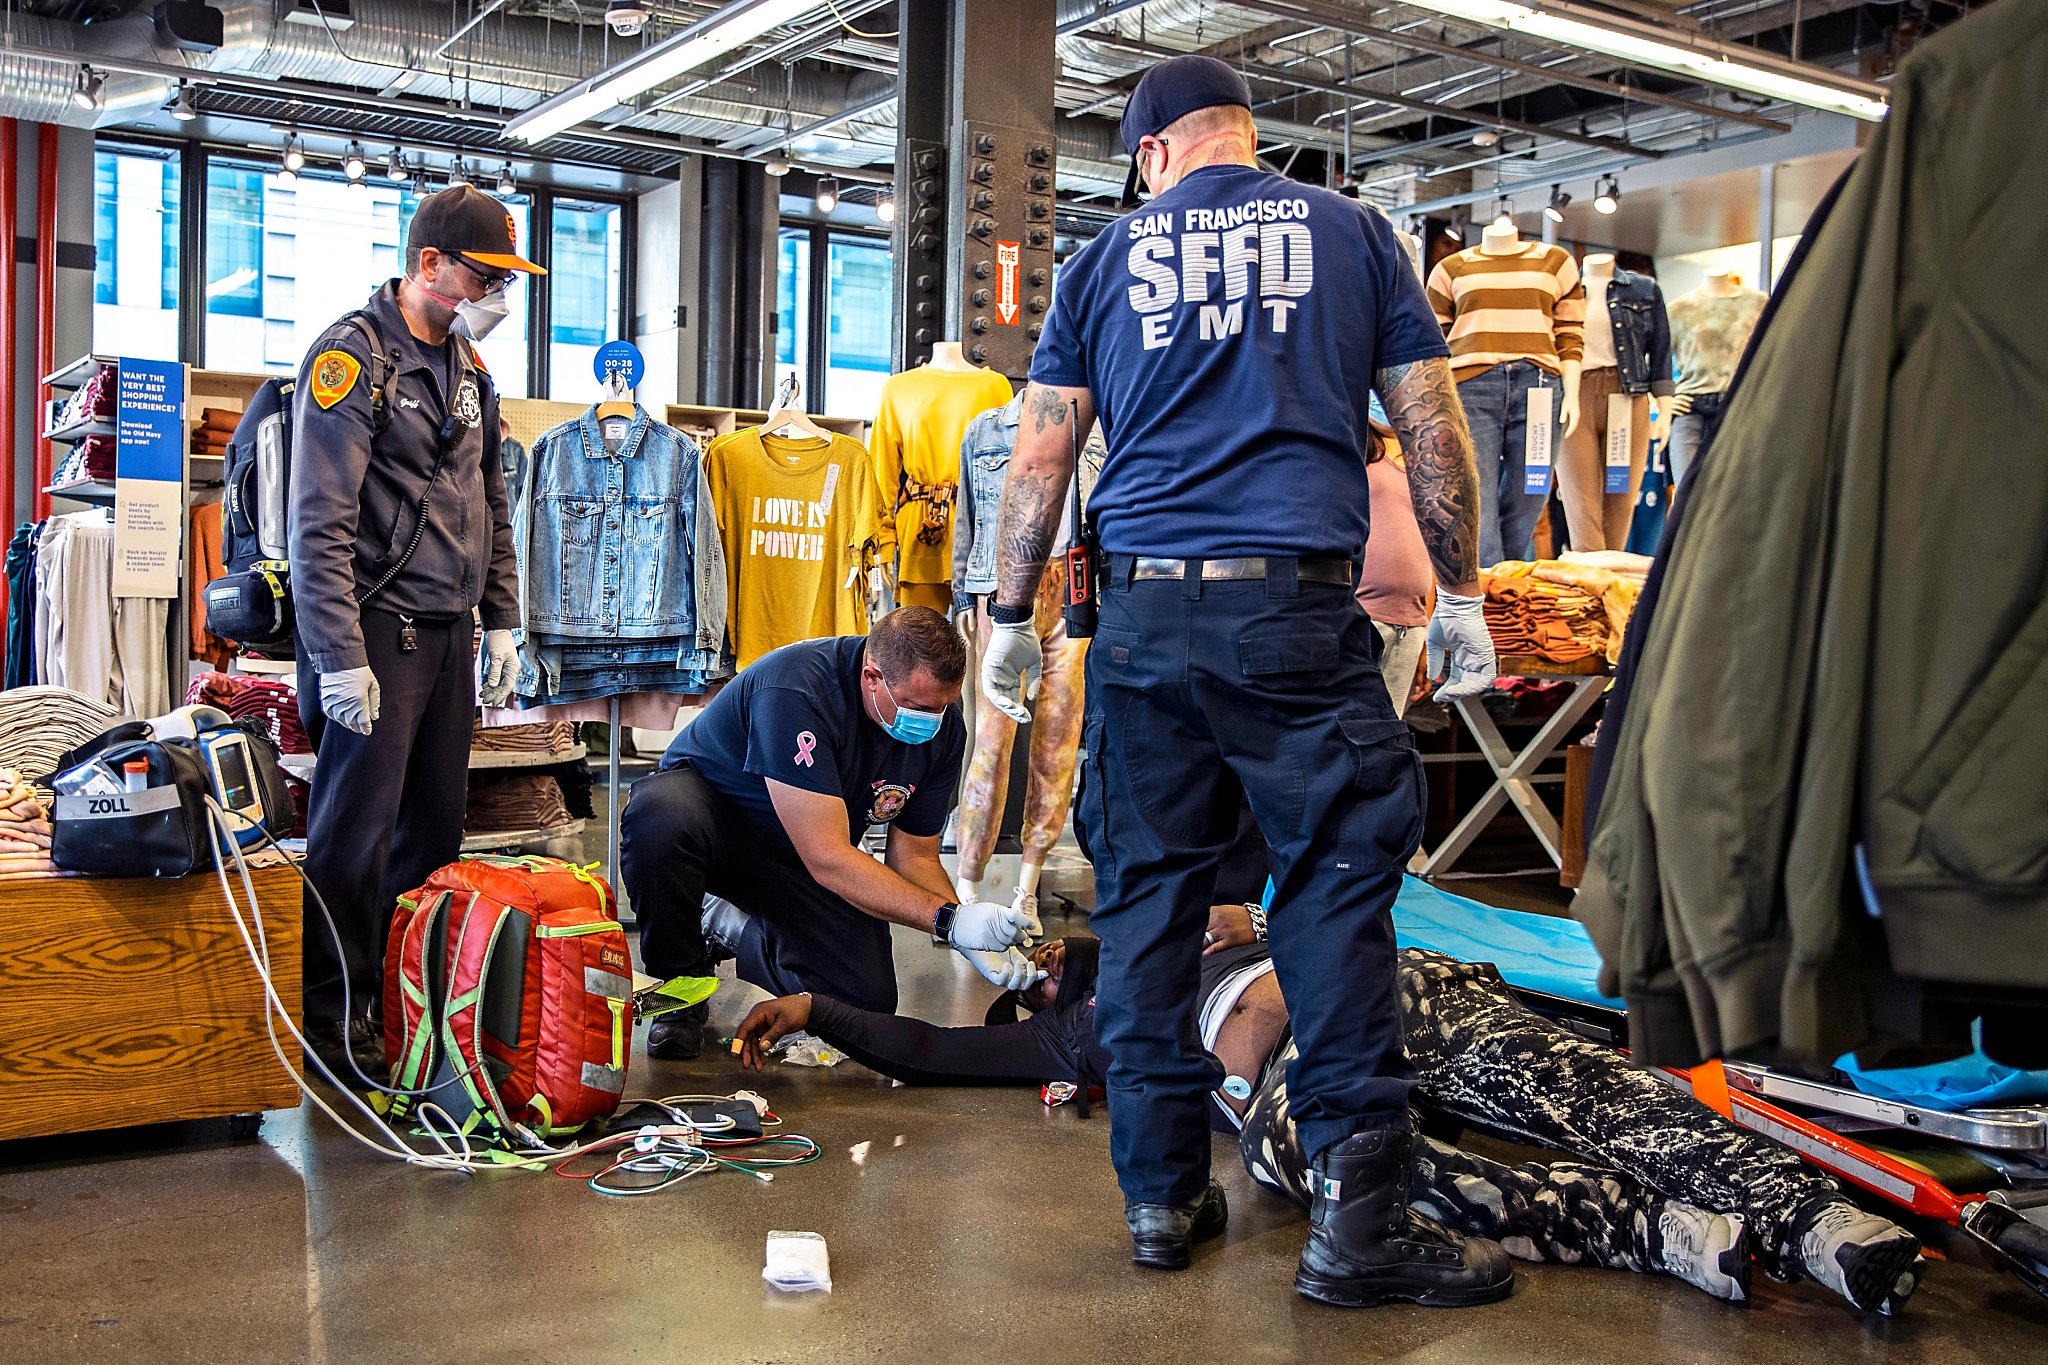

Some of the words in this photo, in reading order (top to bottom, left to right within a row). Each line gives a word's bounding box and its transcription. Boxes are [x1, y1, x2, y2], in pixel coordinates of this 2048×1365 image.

[1128, 213, 1172, 239] SAN
[1186, 199, 1309, 230] FRANCISCO
[1001, 250, 1015, 261] FIRE
[1128, 222, 1313, 313] SFFD
[122, 372, 146, 380] WANT
[149, 374, 164, 382] THE
[122, 381, 143, 390] VERY
[146, 384, 166, 392] BEST
[122, 391, 163, 401] SHOPPING
[122, 401, 176, 412] EXPERIENCE?
[121, 421, 152, 429] Download
[753, 497, 804, 527] LOVE
[808, 501, 825, 528] IS
[750, 530, 824, 560] POWER
[212, 600, 239, 610] MERET
[89, 798, 130, 813] ZOLL
